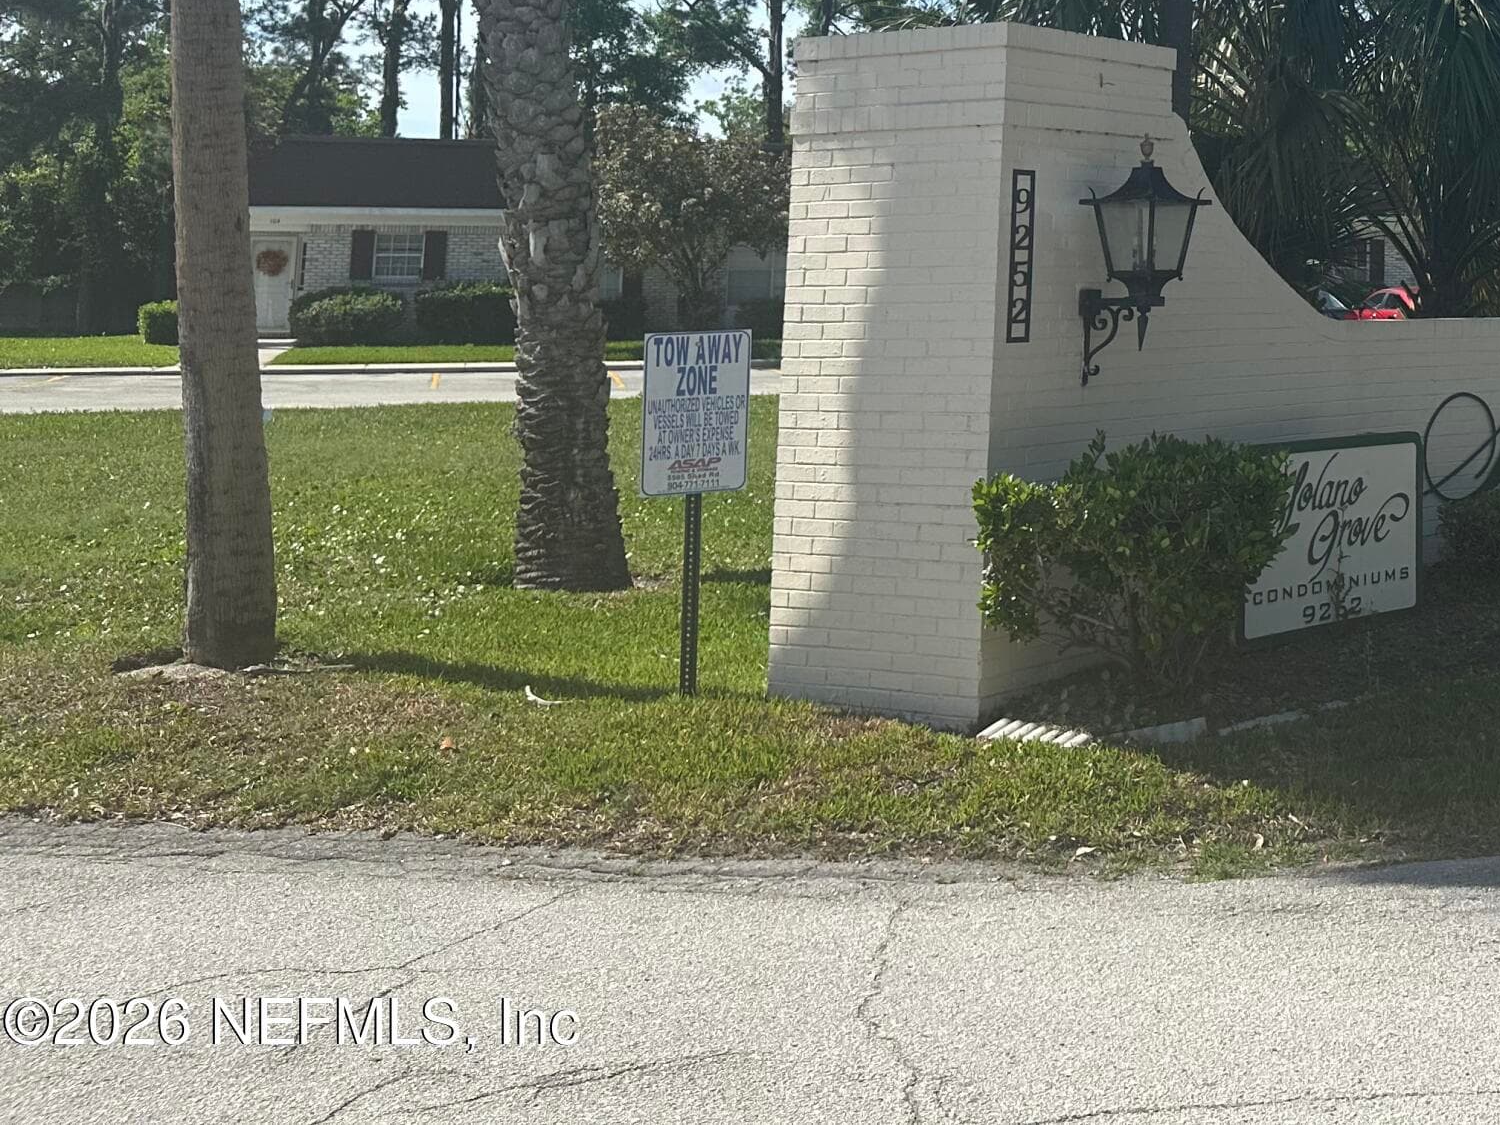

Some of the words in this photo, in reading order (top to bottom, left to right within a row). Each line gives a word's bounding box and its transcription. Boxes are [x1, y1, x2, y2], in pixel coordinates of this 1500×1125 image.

[1013, 188, 1030, 324] 9252
[653, 336, 690, 367] TOW
[695, 333, 743, 365] AWAY
[676, 365, 718, 397] ZONE
[647, 397, 701, 415] UNAUTHORIZED
[702, 395, 734, 411] VEHICLES
[735, 394, 746, 409] OR
[653, 413, 685, 430] VESSELS
[685, 412, 702, 428] WILL
[703, 411, 713, 427] BE
[715, 410, 739, 425] TOWED
[657, 430, 668, 445] AT
[702, 426, 734, 442] EXPENSE
[674, 445, 680, 458] A
[681, 444, 695, 458] DAY
[703, 442, 720, 457] DAYS
[721, 442, 727, 456] A
[667, 457, 722, 470] ASAP
[1277, 452, 1367, 534] Solano
[1308, 492, 1410, 583] Grove
